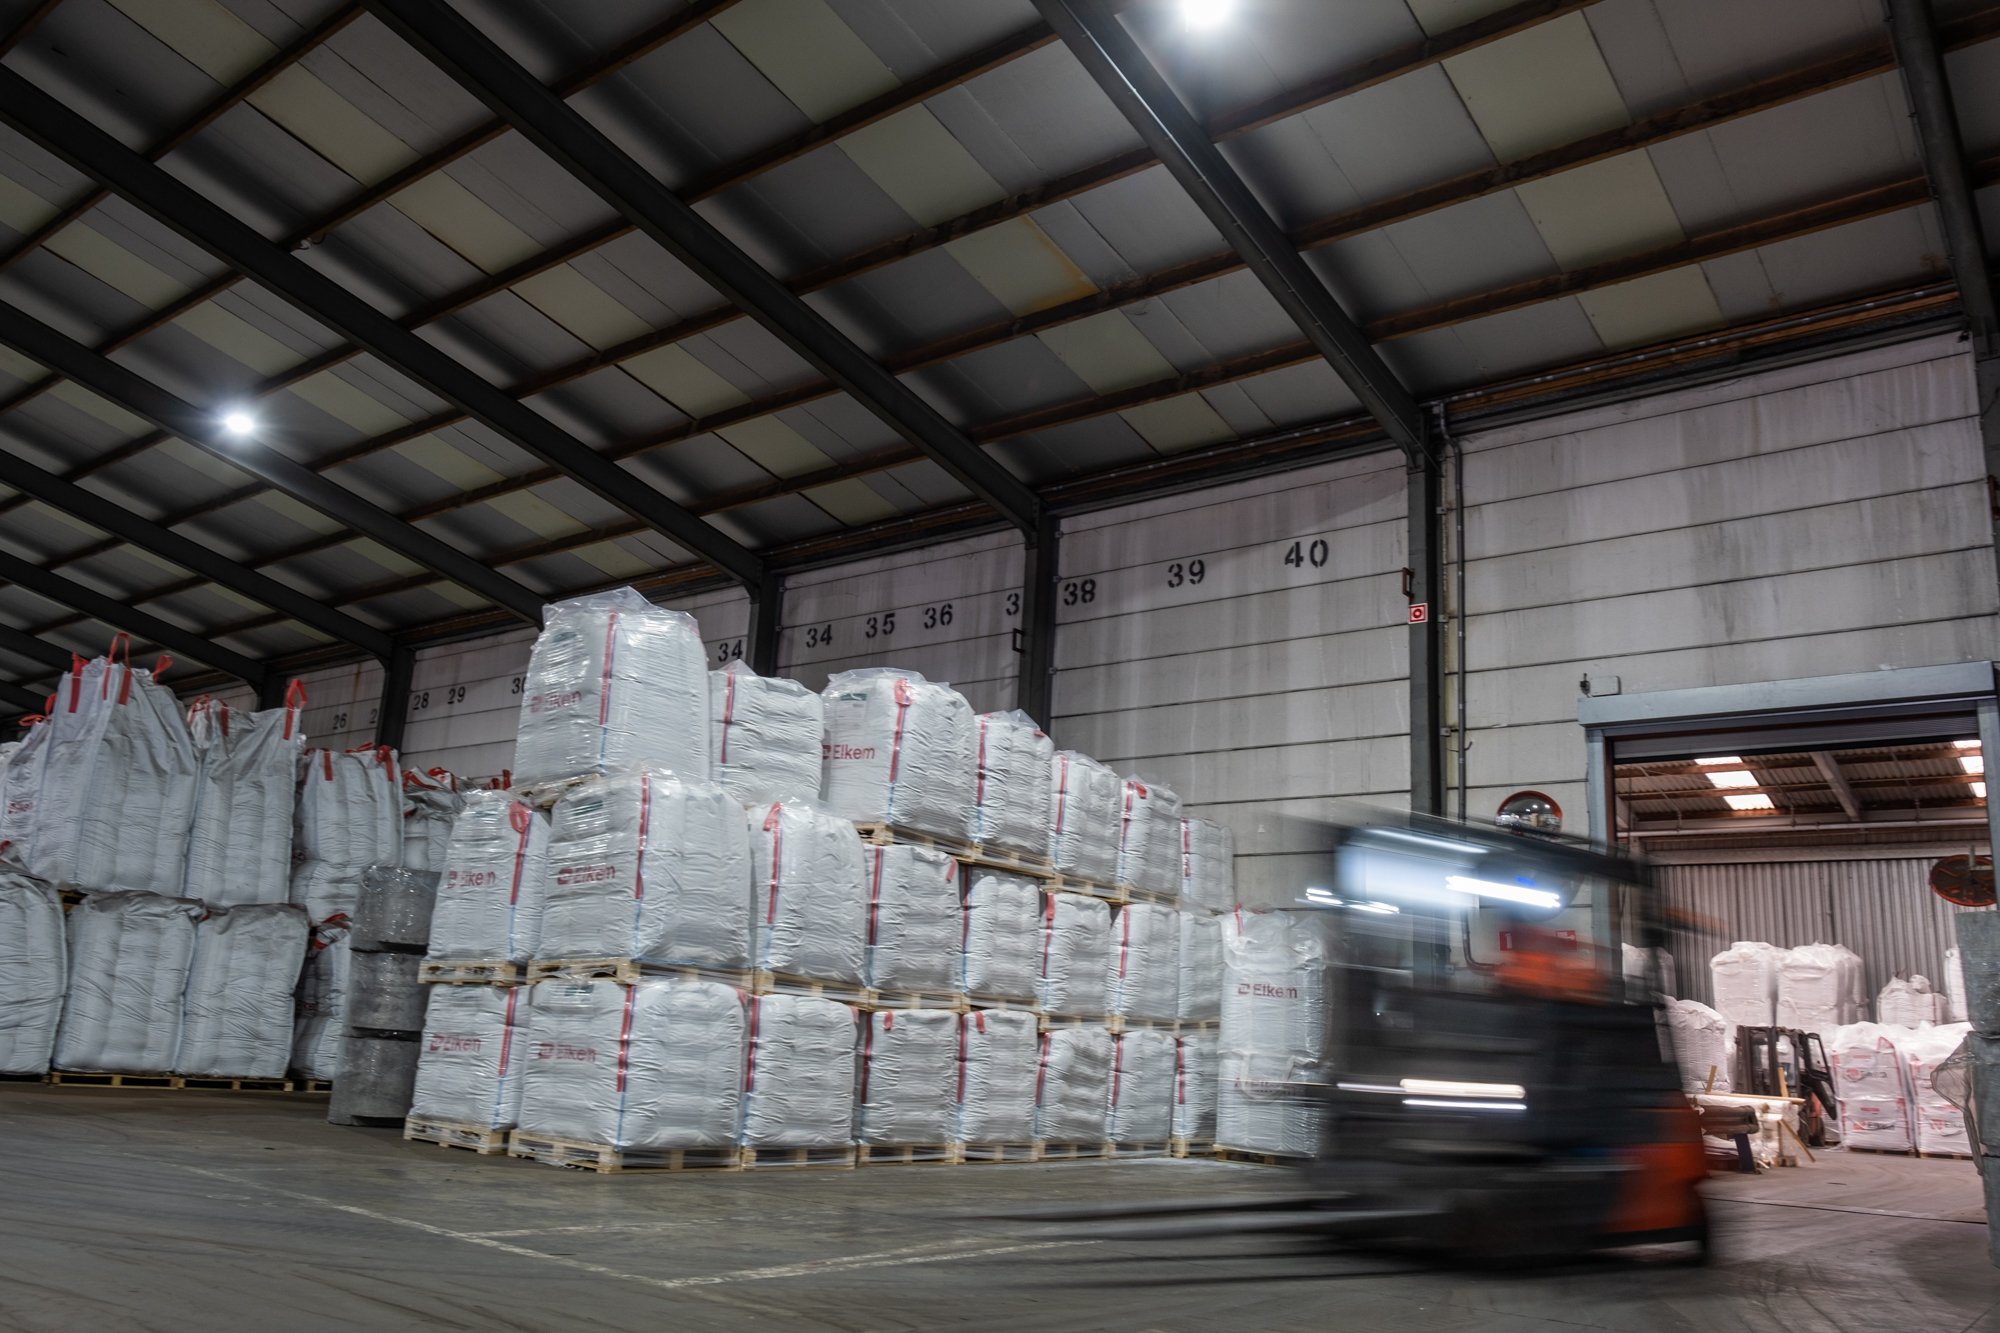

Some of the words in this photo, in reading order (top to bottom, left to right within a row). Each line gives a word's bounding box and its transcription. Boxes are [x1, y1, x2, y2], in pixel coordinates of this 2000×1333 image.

[1284, 539, 1329, 568] 40
[1166, 559, 1206, 588] 39
[1005, 592, 1020, 616] 3
[1063, 578, 1096, 606] 38
[865, 612, 896, 638] 35
[924, 603, 953, 629] 36
[806, 623, 833, 648] 34
[718, 639, 744, 662] 34
[412, 692, 430, 710] 28
[447, 686, 466, 705] 29
[332, 713, 347, 730] 26
[833, 743, 876, 760] Elkem
